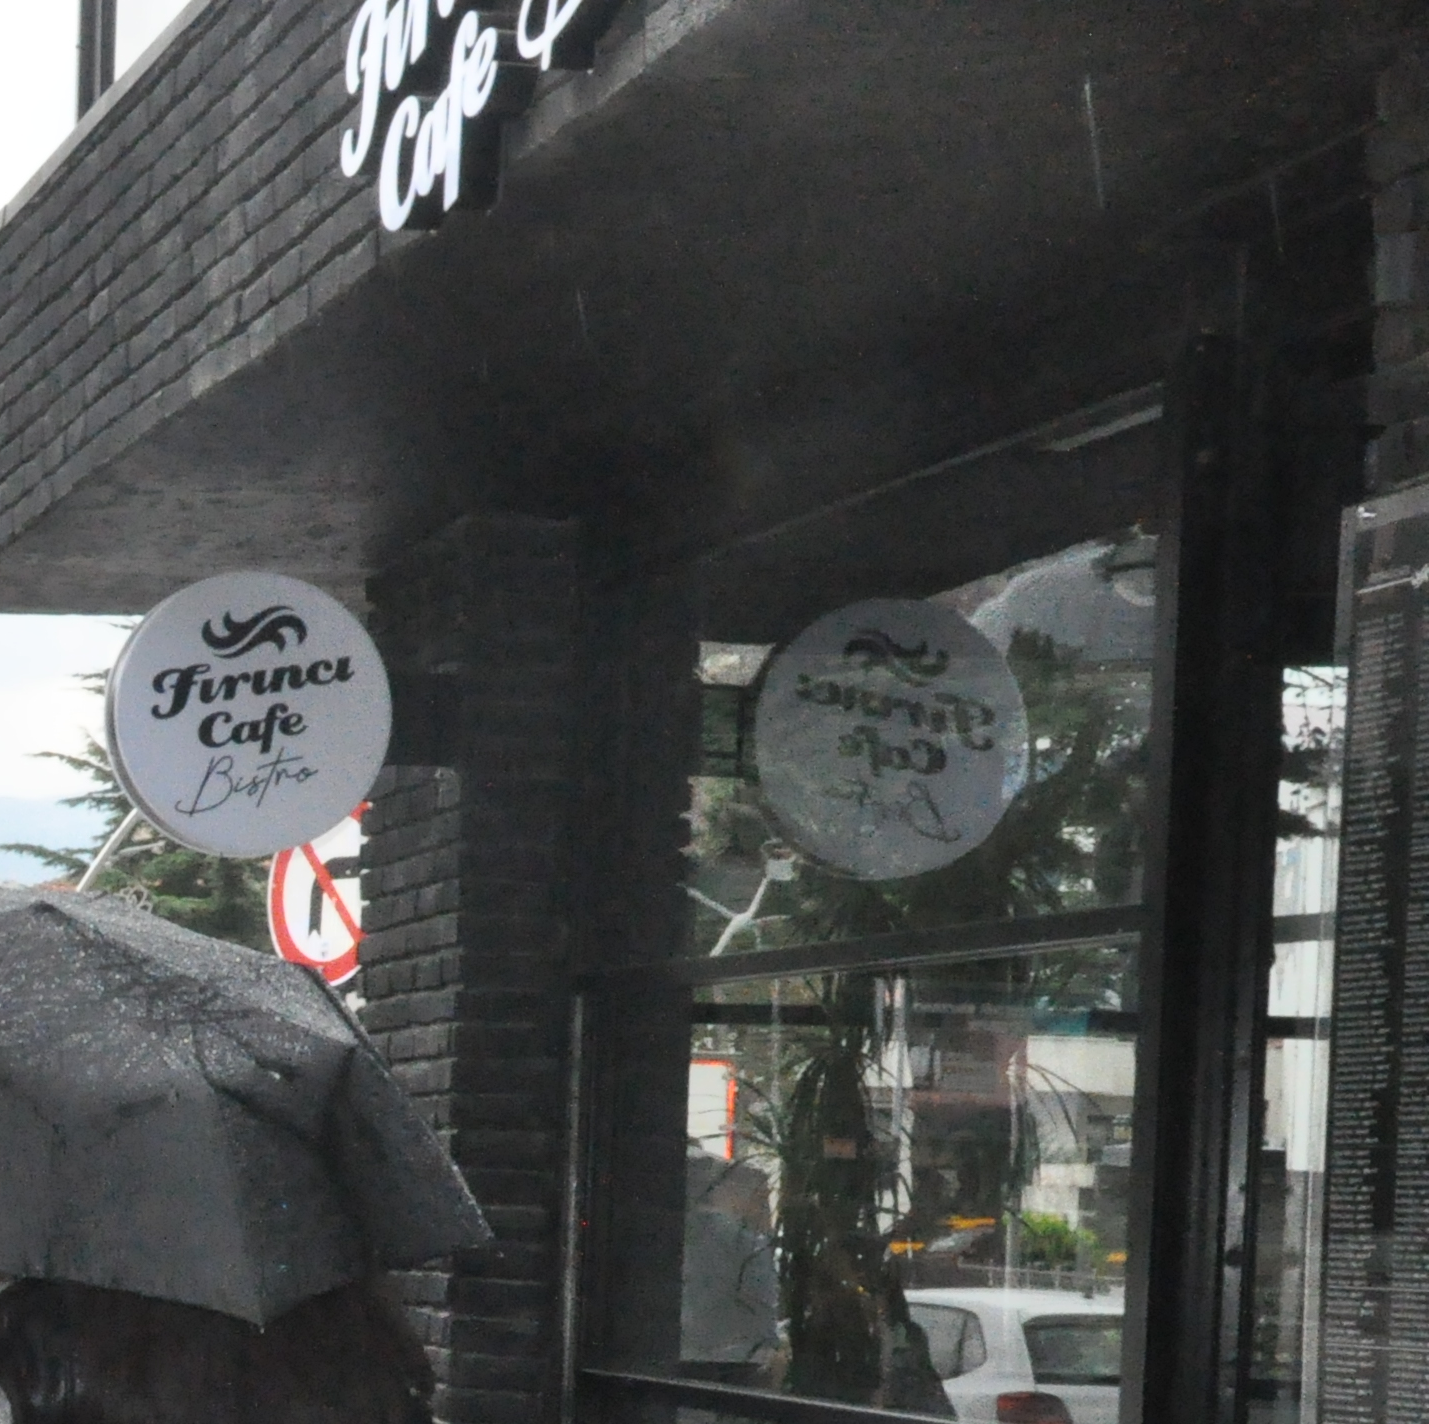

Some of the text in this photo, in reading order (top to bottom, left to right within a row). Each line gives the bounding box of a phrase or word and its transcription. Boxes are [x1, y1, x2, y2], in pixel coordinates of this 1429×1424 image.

[379, 10, 498, 231] Cafe
[151, 656, 355, 719] Fırıncı
[198, 703, 309, 754] Cafe
[174, 747, 319, 817] Bistro
